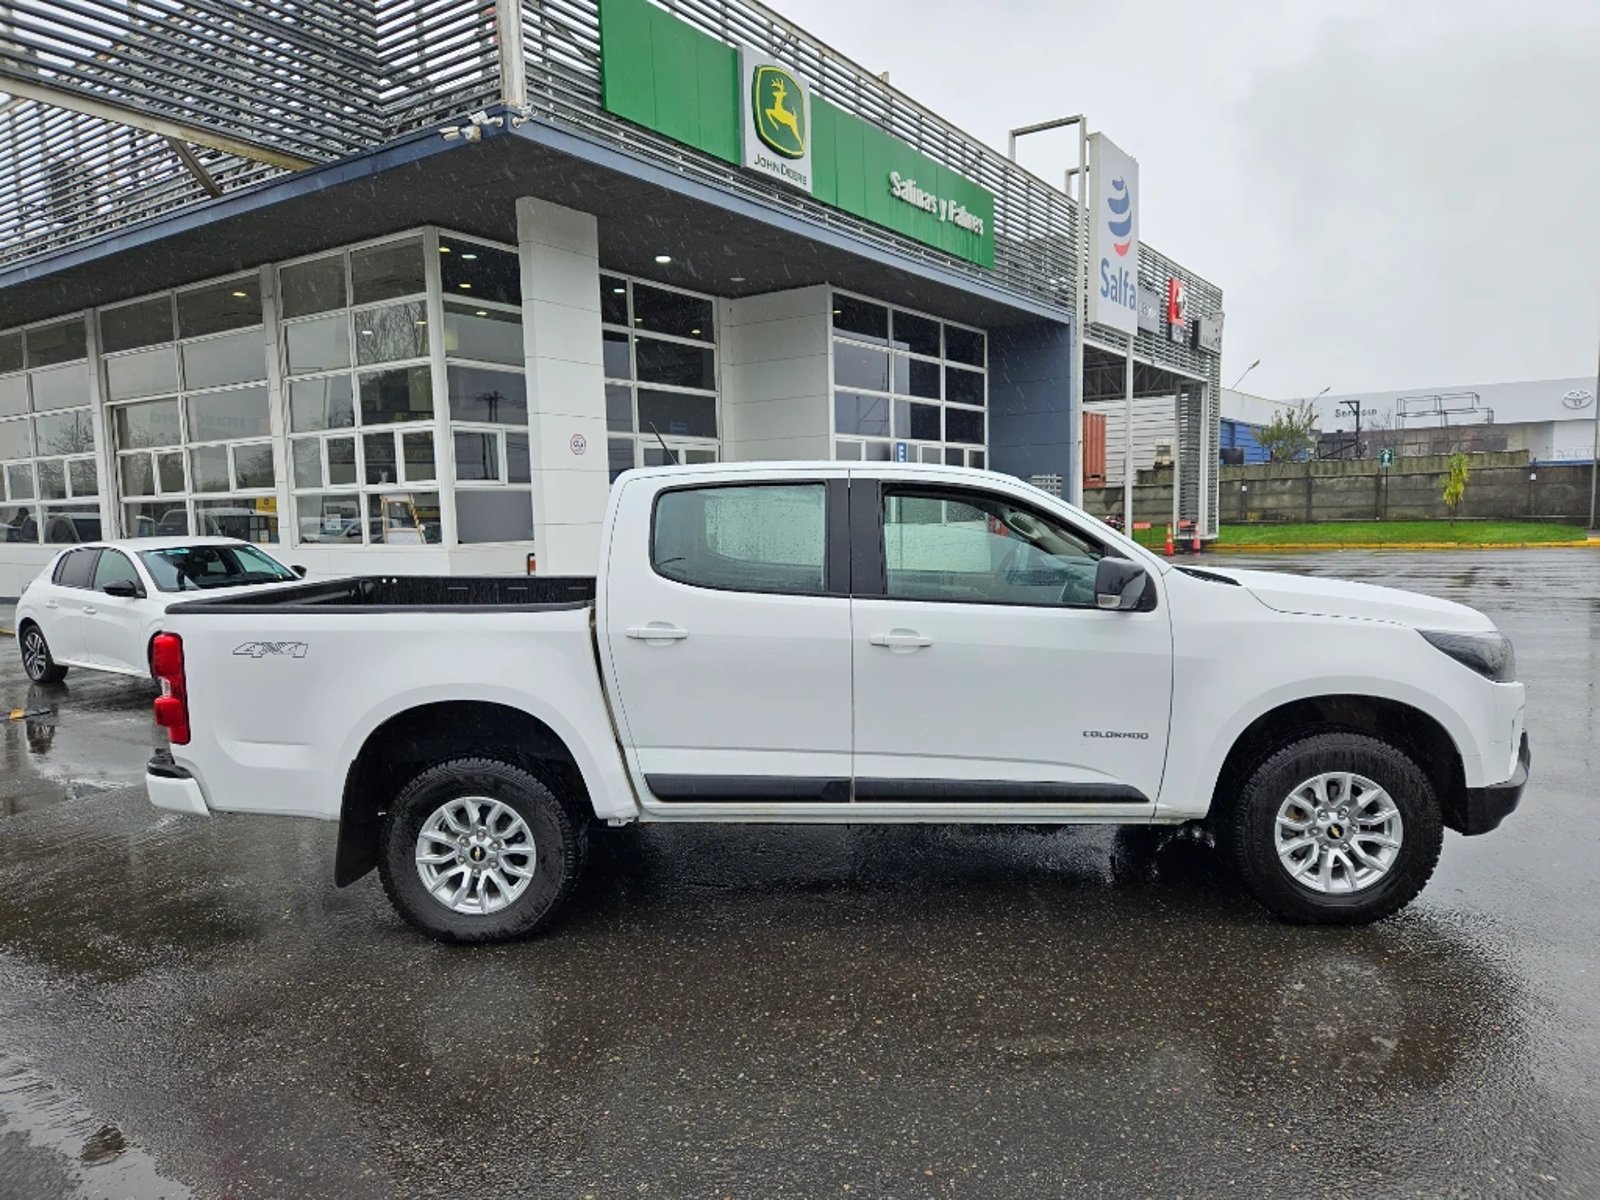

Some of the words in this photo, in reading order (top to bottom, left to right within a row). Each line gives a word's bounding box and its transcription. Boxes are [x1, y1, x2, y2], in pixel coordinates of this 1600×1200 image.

[754, 154, 780, 173] JOHN
[780, 162, 807, 186] DEERE
[938, 198, 948, 223] y
[1100, 257, 1137, 312] Salfa
[1082, 730, 1149, 740] COLORADO
